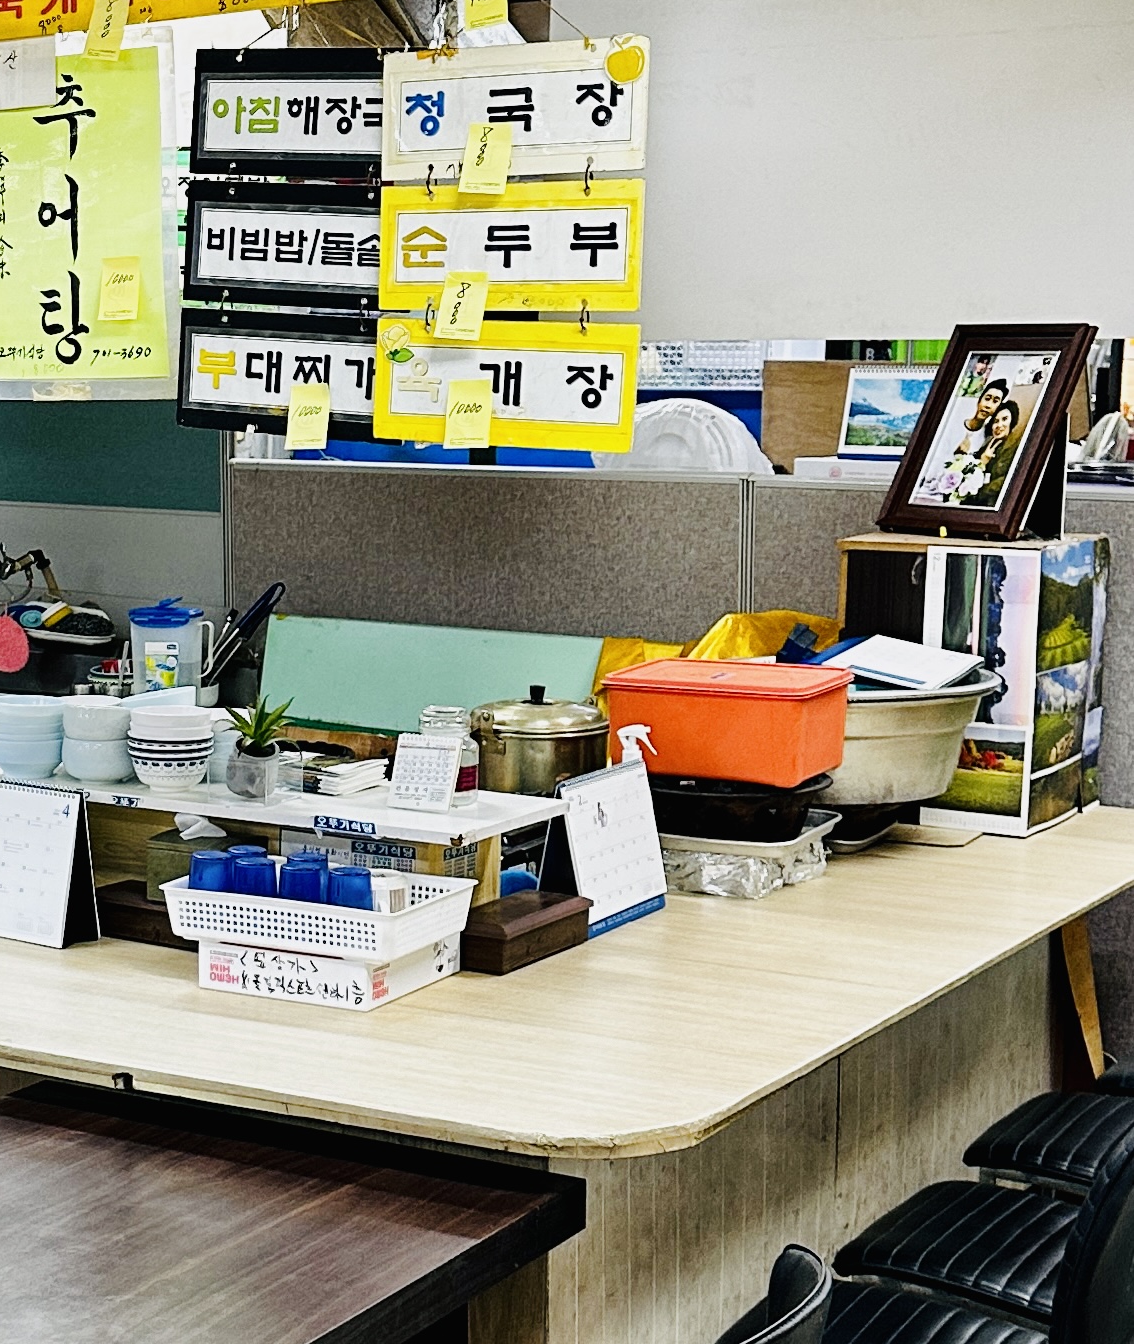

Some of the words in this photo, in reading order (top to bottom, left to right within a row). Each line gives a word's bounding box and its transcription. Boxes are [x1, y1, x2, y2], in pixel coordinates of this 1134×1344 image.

[405, 82, 625, 136] 청국장
[33, 74, 97, 365] 추어탕
[401, 222, 620, 268] 순두부
[316, 816, 375, 834] 오뚜기식당
[354, 842, 414, 858] 오뚜기식당
